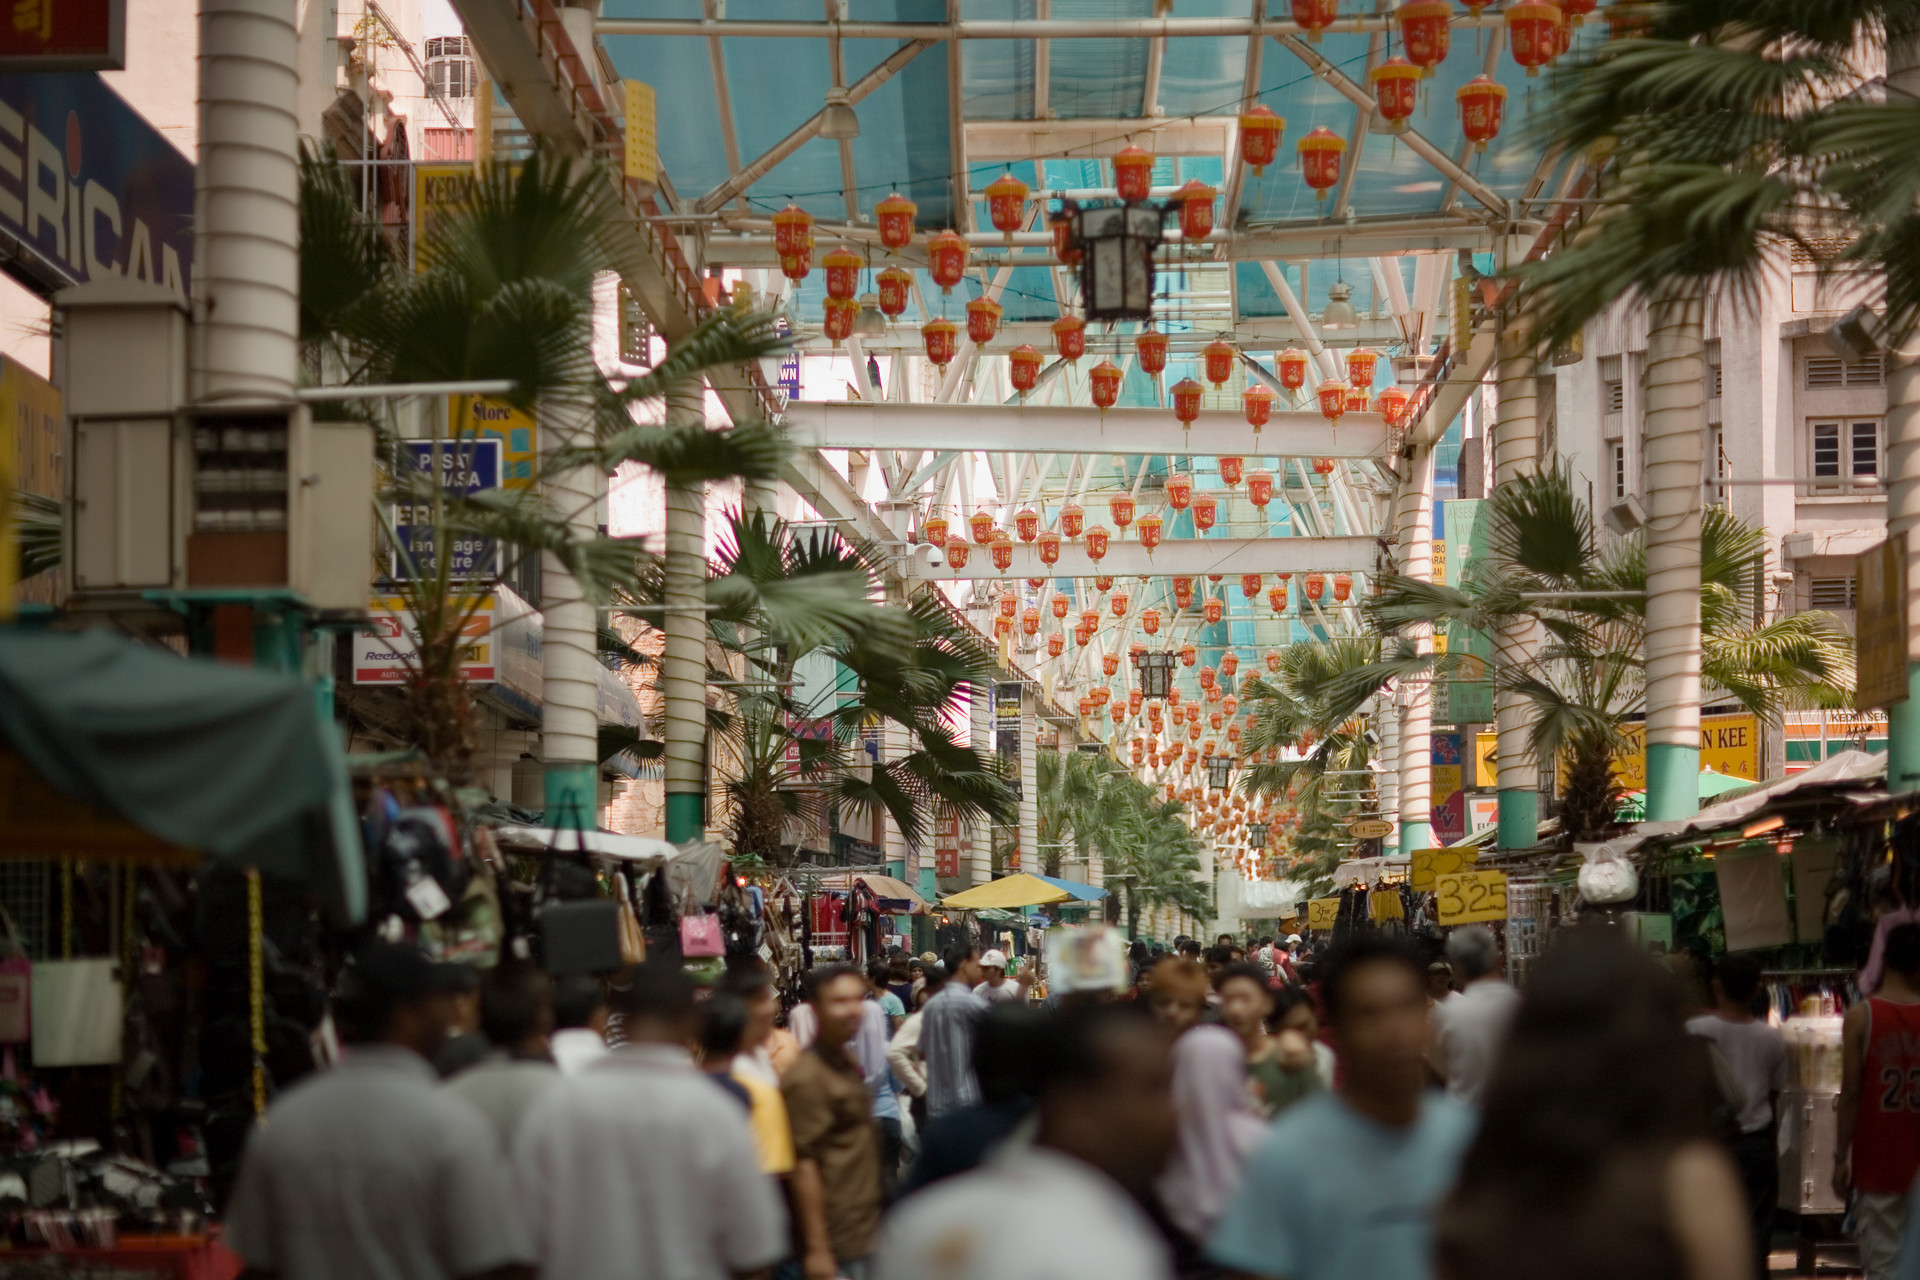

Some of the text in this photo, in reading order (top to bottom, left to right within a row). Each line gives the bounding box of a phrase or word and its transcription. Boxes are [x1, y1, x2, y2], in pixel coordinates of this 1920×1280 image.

[473, 402, 511, 420] Store
[364, 651, 417, 661] Reebok
[1717, 727, 1747, 748] KEE
[1440, 878, 1466, 918] 3
[1469, 882, 1507, 912] 25
[1310, 902, 1322, 923] 3
